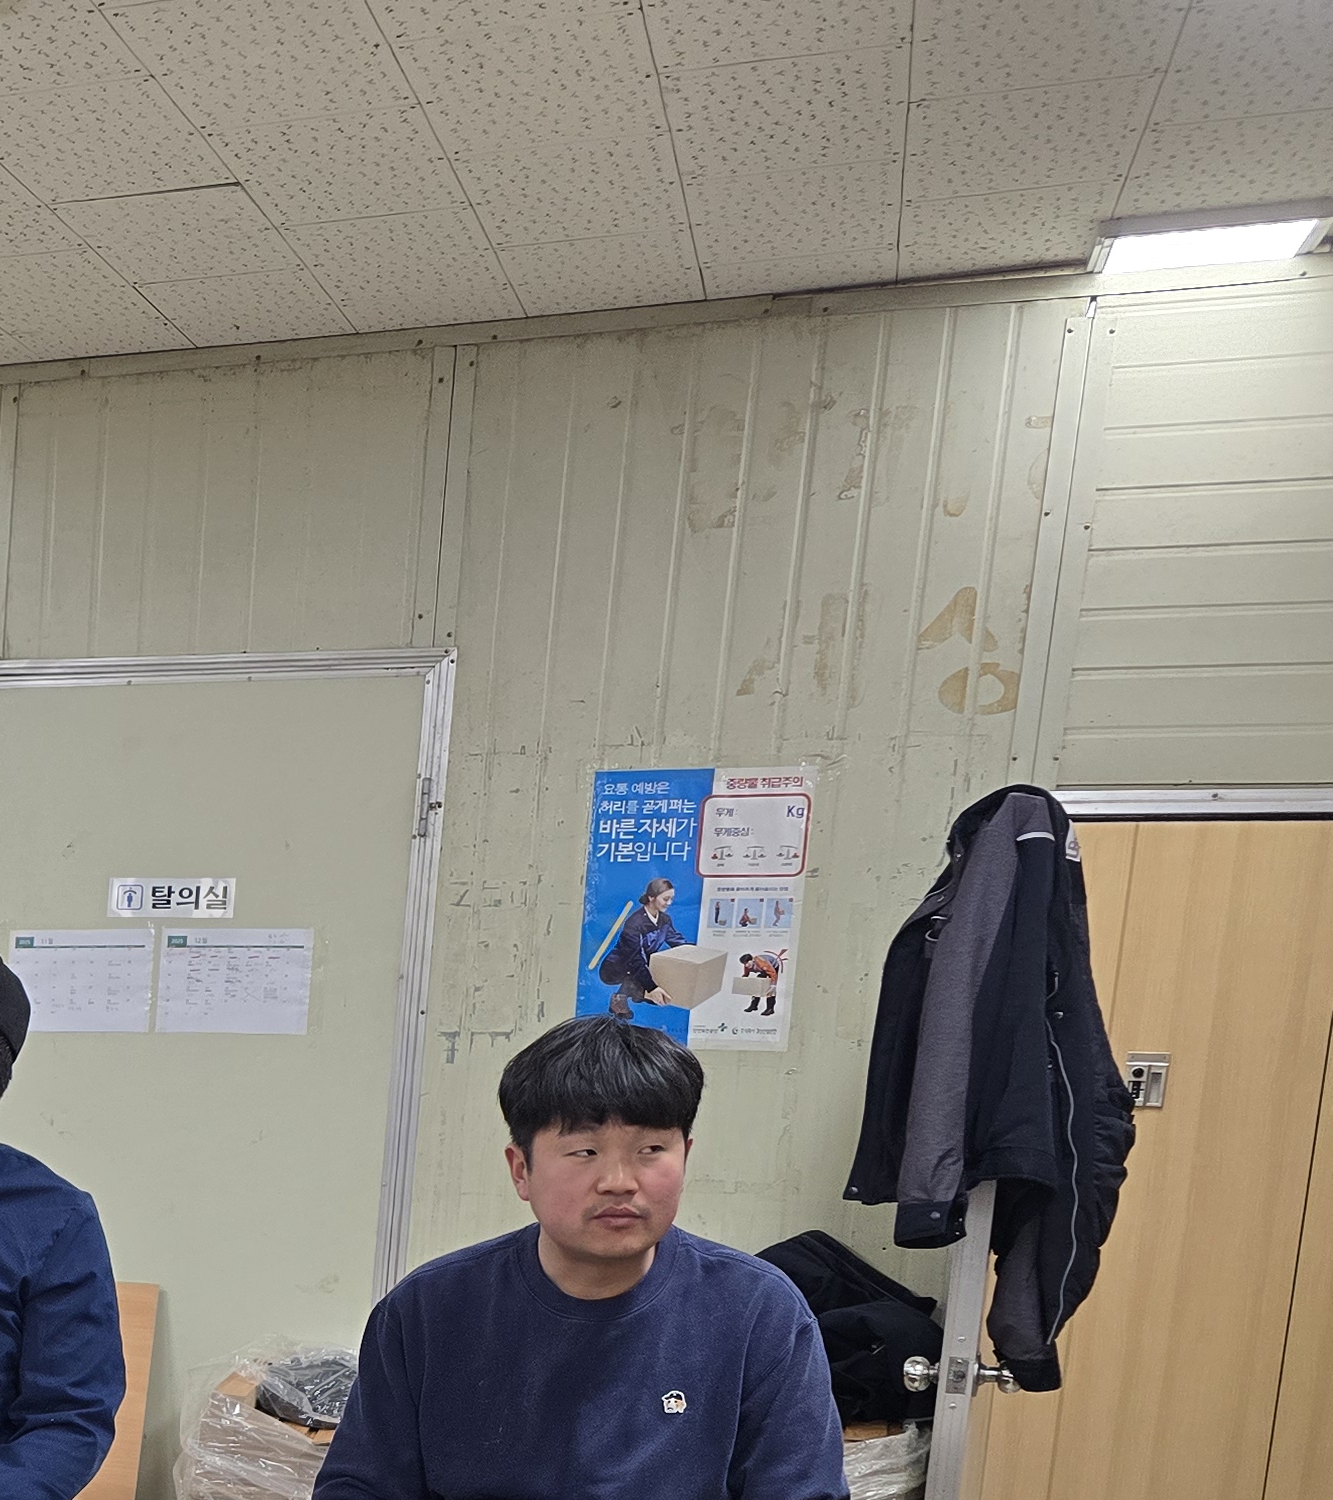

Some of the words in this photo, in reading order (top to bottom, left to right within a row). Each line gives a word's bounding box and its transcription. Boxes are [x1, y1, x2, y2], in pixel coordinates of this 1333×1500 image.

[602, 783, 629, 796] 요통
[631, 781, 671, 795] 예방은
[726, 777, 758, 790] 중량물
[760, 776, 804, 788] 취급주의
[598, 800, 639, 815] 허리를
[786, 805, 806, 819] Kg
[596, 841, 692, 863] 기본입니다
[151, 885, 228, 911] 탈의실
